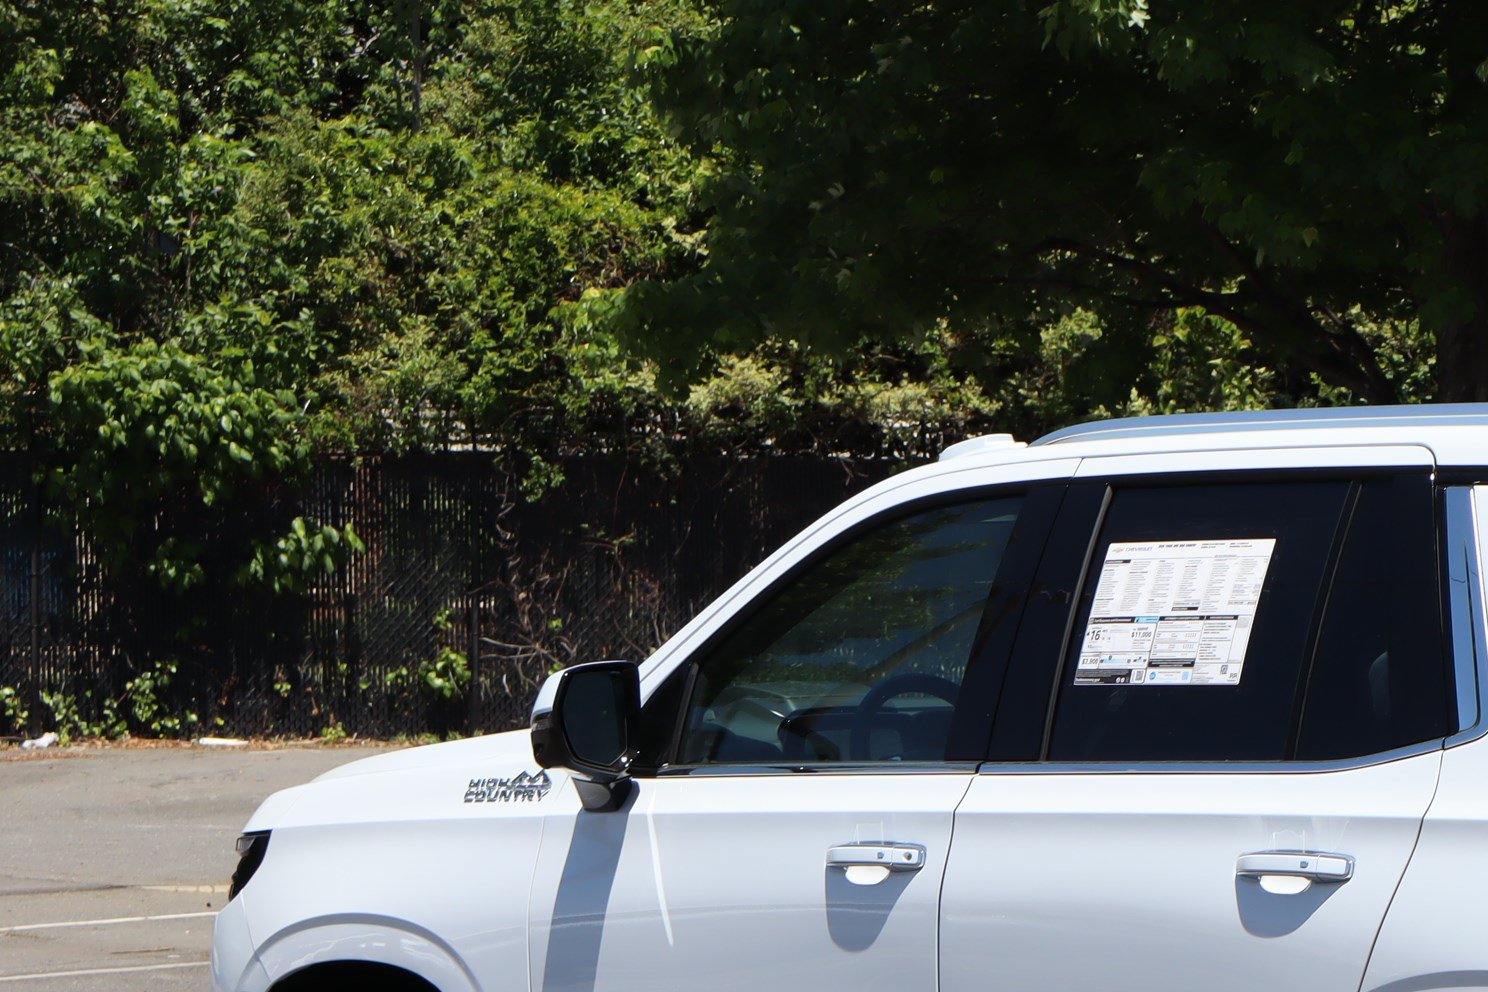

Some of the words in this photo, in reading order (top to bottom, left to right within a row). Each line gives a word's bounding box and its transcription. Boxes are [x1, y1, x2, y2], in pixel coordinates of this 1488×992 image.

[1091, 630, 1101, 641] 16
[468, 777, 510, 789] HIGH
[464, 788, 549, 803] COUNTRY
